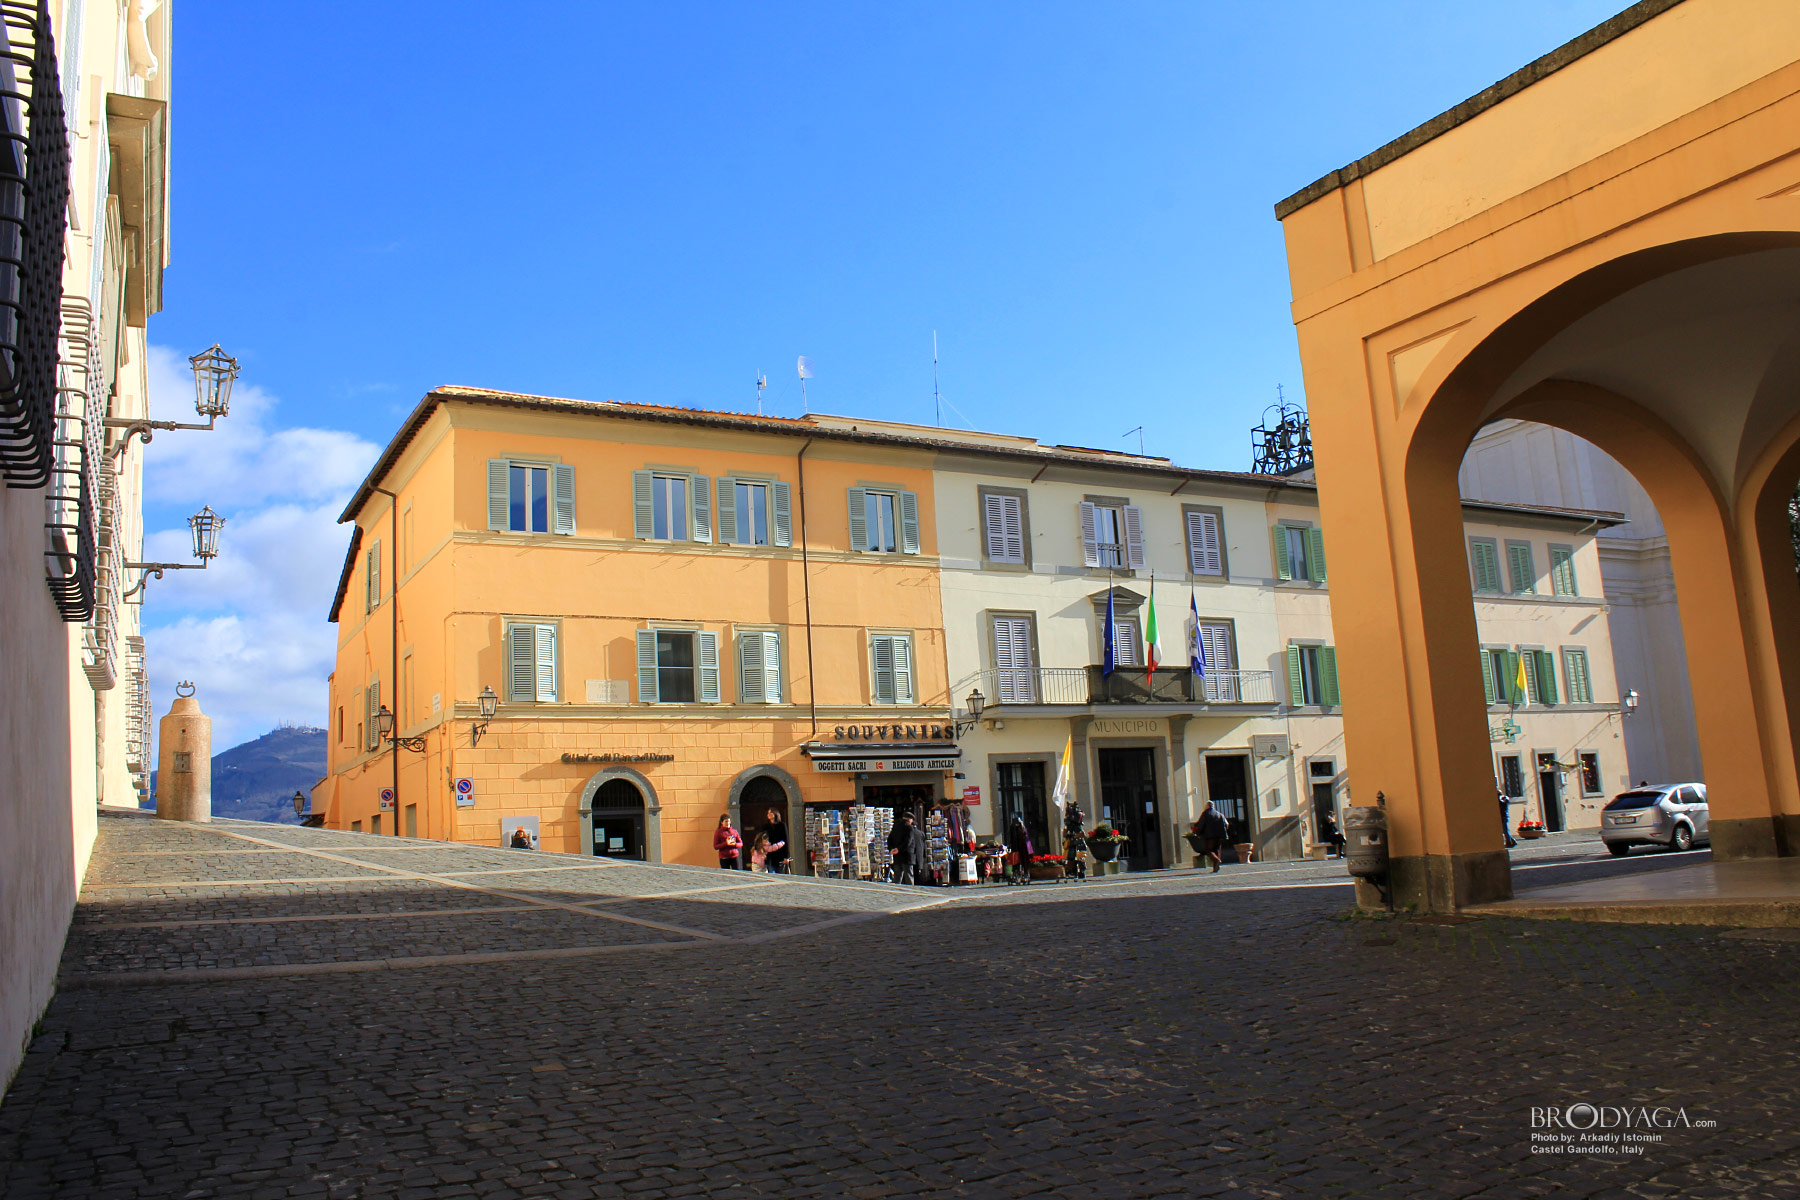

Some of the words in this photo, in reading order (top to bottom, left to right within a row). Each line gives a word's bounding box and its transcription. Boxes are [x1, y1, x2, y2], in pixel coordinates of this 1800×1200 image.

[834, 724, 954, 741] SOUVENIRS
[1094, 720, 1157, 733] MUNICIPIO
[818, 762, 845, 771] OGGETTI
[848, 761, 867, 771] SACRI
[892, 760, 925, 769] RELIGIOUS
[927, 759, 955, 769] ARTICLES
